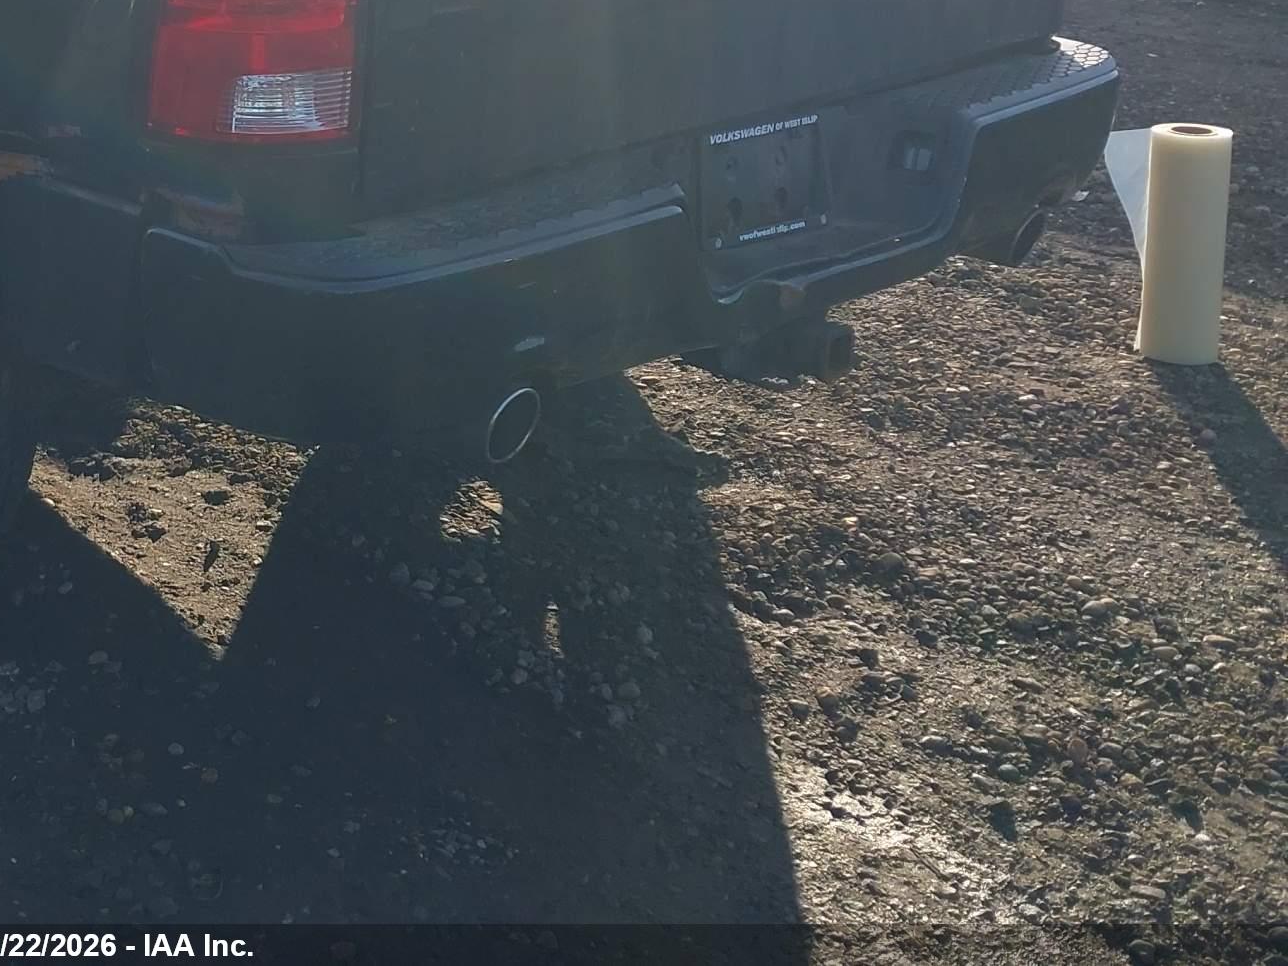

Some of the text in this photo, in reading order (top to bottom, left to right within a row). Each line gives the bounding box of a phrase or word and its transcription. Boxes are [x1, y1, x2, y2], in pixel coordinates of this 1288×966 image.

[709, 122, 775, 145] VOLKSWAGEN
[784, 117, 801, 129] WEST
[801, 114, 818, 126] ISLIP
